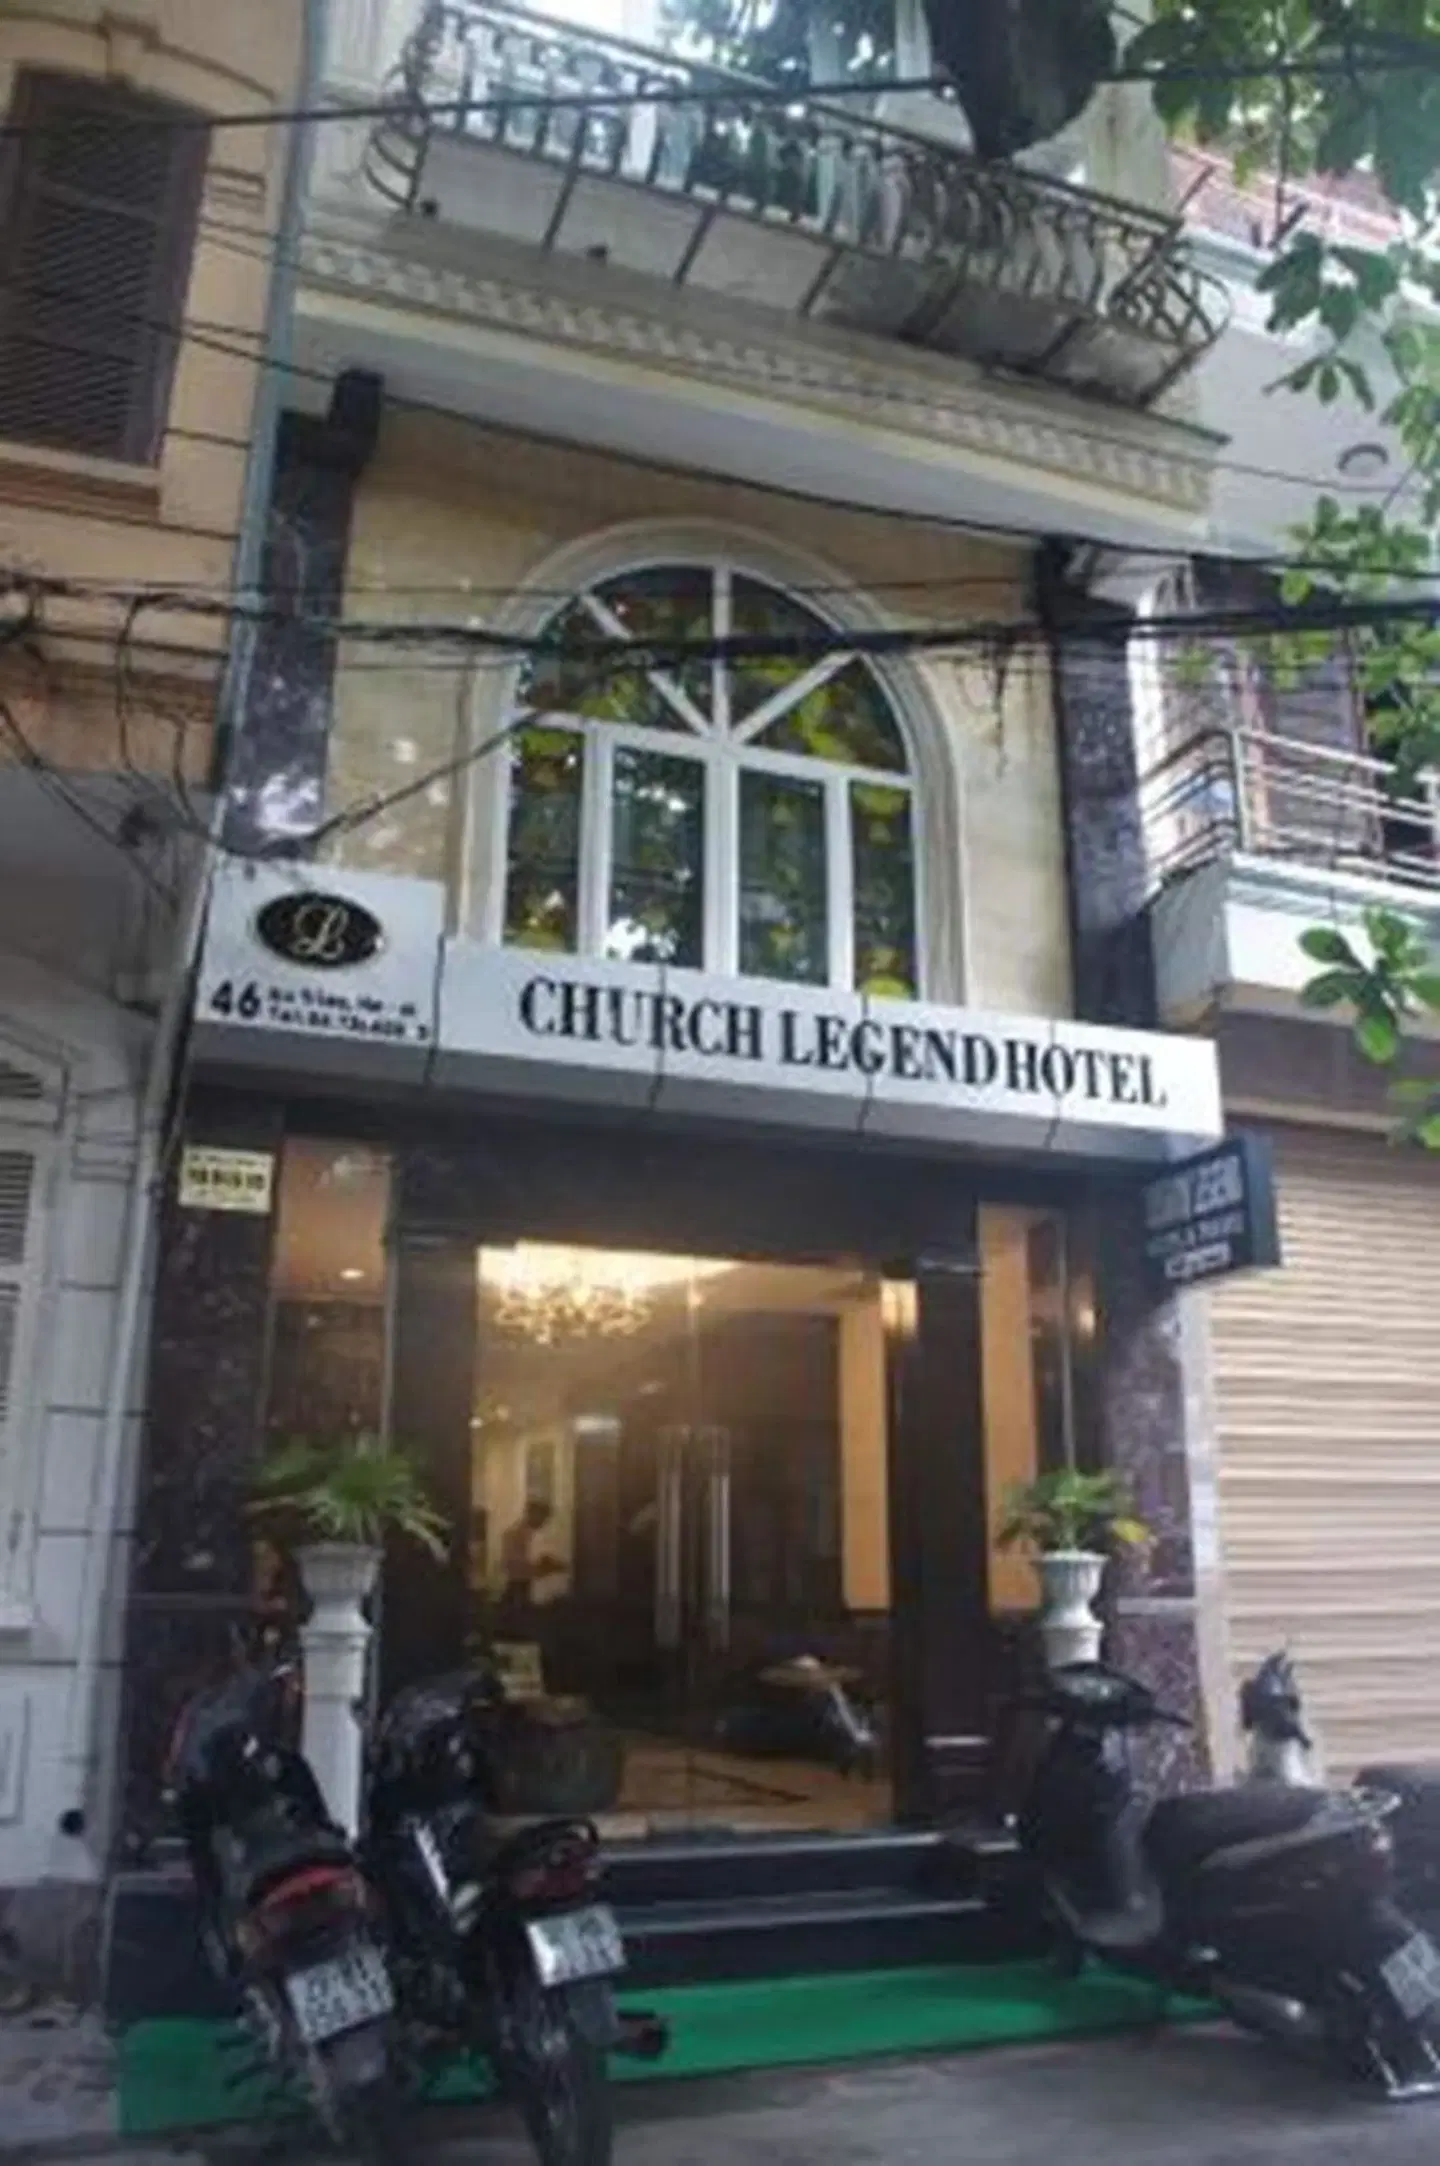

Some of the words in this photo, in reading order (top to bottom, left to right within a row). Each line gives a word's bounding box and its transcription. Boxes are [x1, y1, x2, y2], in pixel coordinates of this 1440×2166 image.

[211, 978, 262, 1018] 46
[519, 976, 764, 1062] CHURCH
[778, 1010, 998, 1086] LEGEND
[1003, 1038, 1168, 1108] HOTEL
